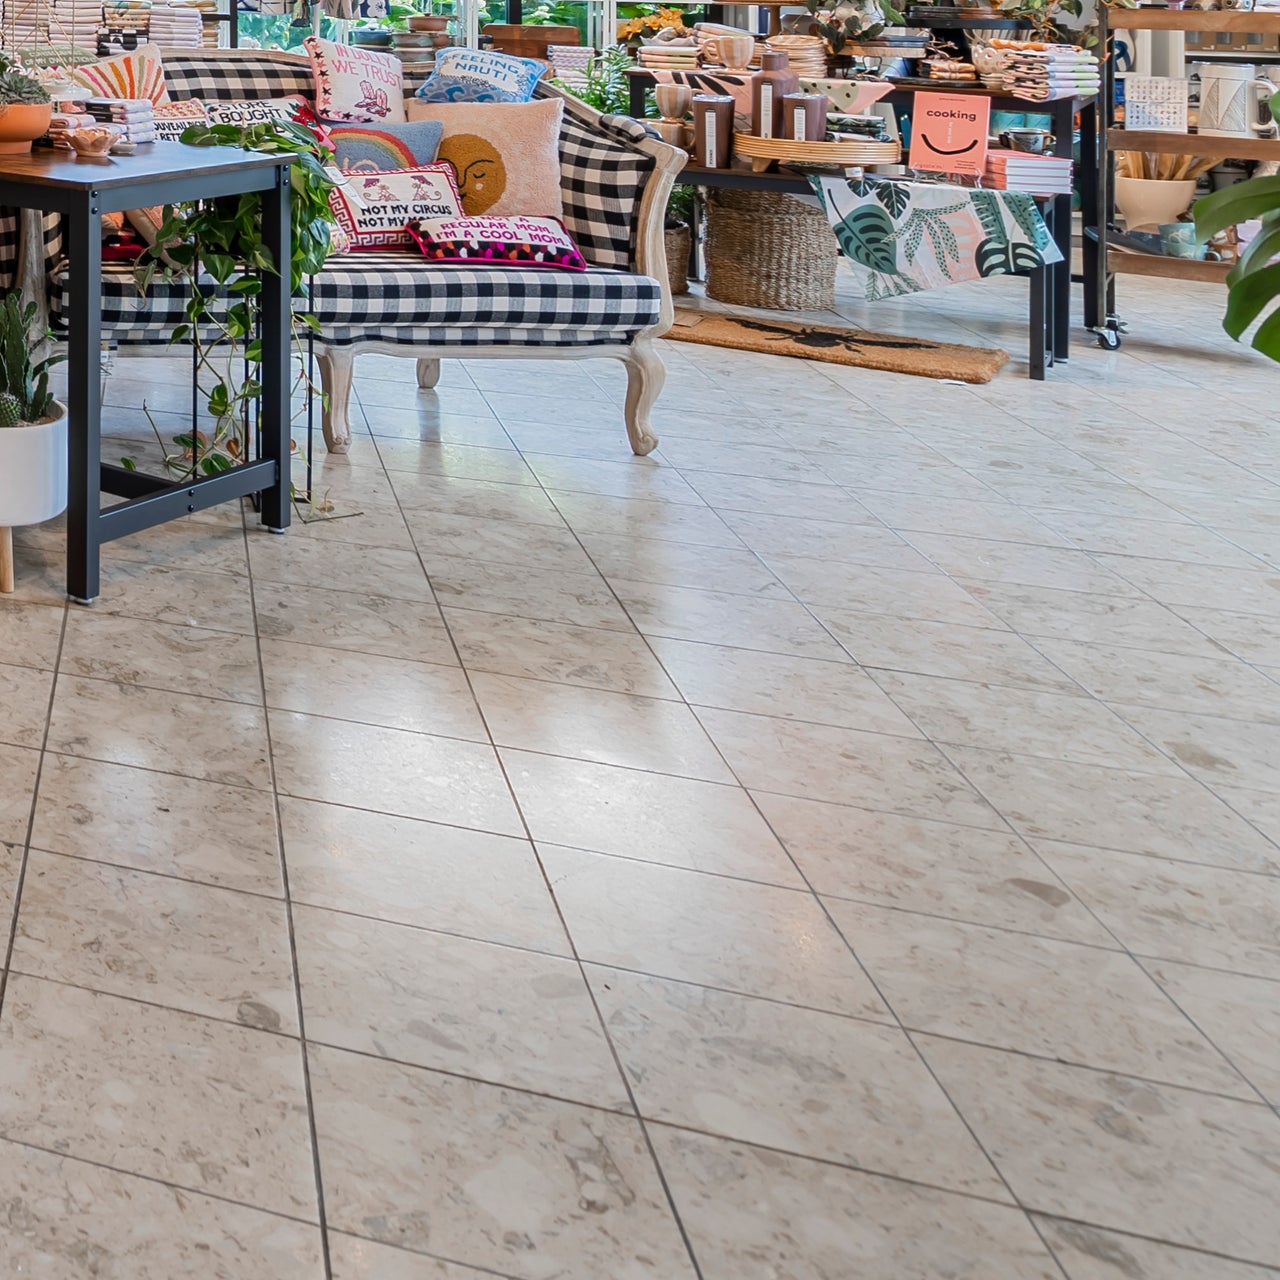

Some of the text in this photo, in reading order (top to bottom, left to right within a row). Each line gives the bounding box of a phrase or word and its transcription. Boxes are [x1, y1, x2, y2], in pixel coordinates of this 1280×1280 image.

[334, 45, 392, 68] IN DOLLY
[450, 53, 520, 75] FEELING
[332, 60, 403, 89] WE TRUST
[454, 62, 508, 81] NAUTI
[218, 100, 274, 111] STORE
[219, 108, 282, 124] BOUGHT
[926, 109, 977, 122] cooking
[154, 122, 187, 131] OUVEAU
[360, 204, 453, 216] NOT MY CIRCUS
[357, 217, 389, 229] NOT
[390, 216, 408, 227] MY
[440, 221, 555, 235] REGULAR MOM.
[436, 229, 570, 246] I'M A COOL MOM.
